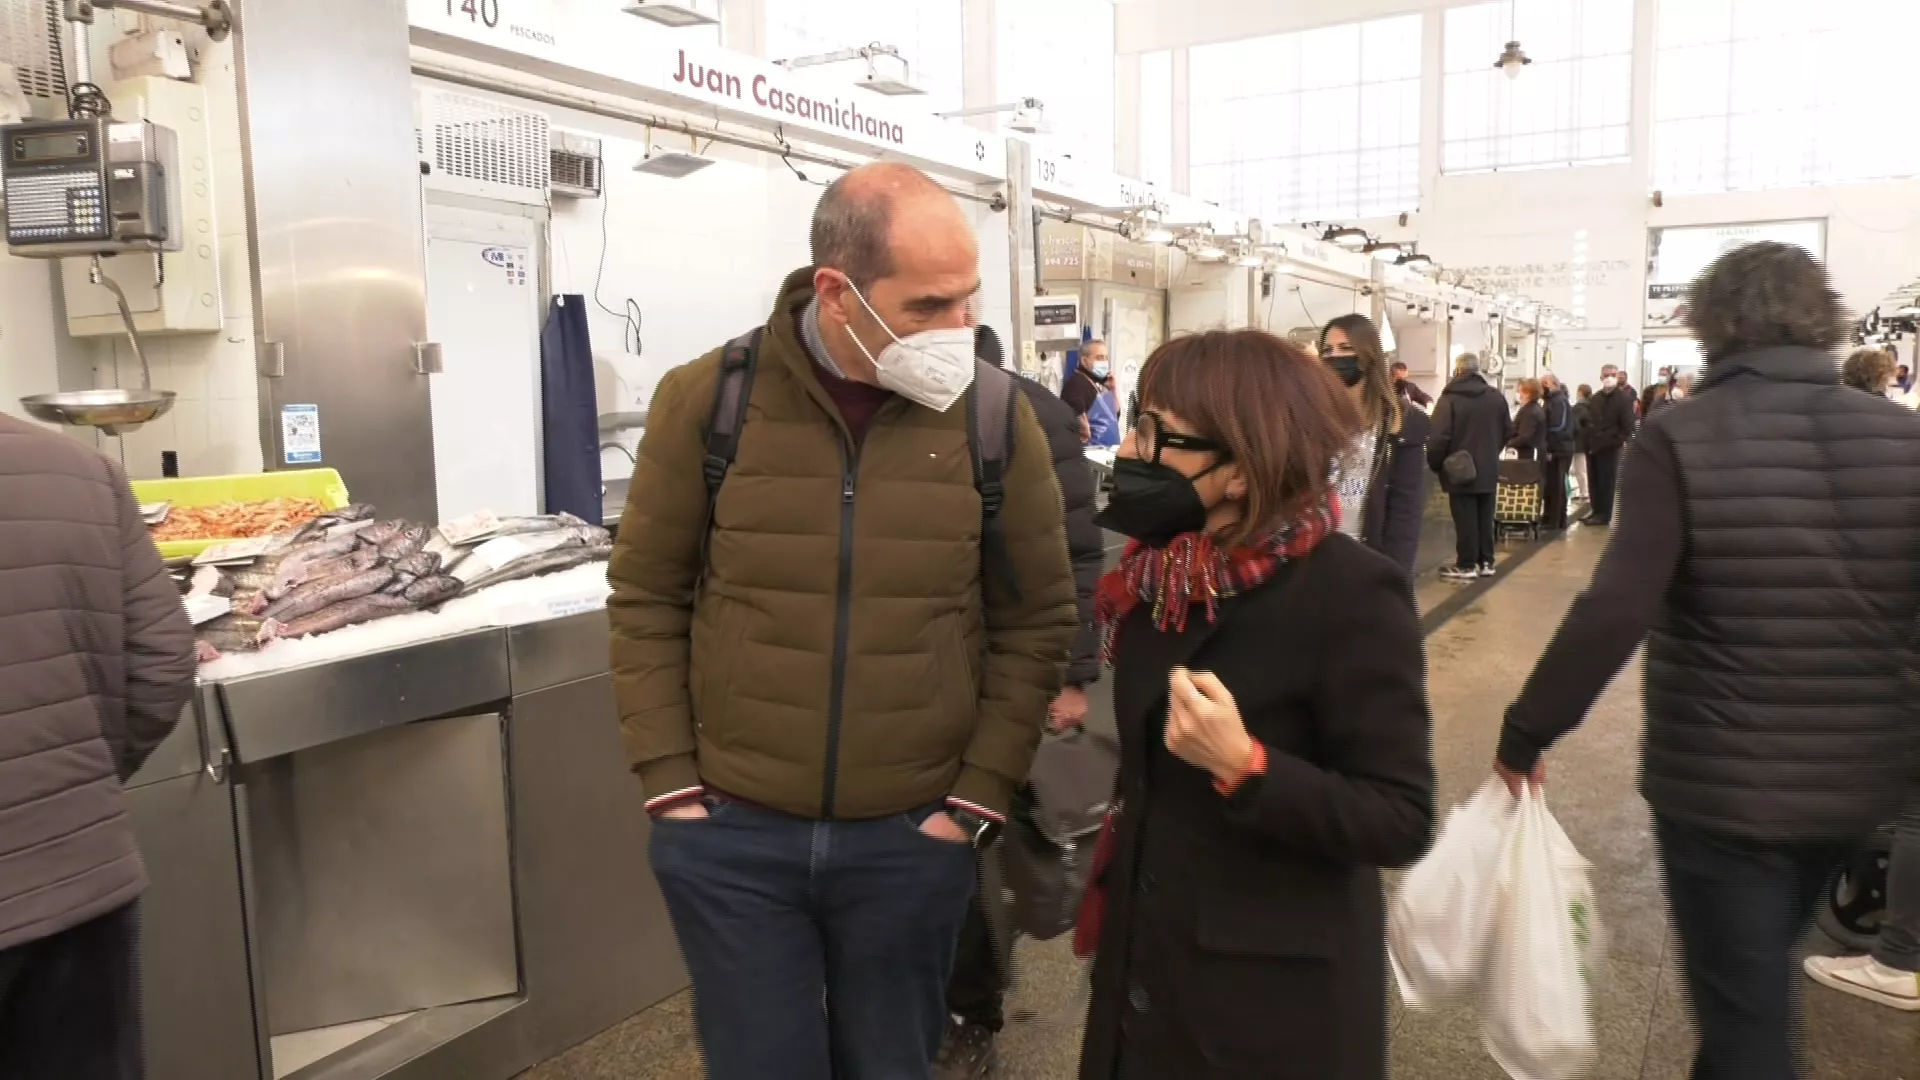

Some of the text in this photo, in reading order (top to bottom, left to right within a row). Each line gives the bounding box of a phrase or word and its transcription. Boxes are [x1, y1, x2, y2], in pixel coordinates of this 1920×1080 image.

[509, 24, 556, 46] PESCADOS
[672, 48, 904, 145] Juan Casamichana
[1037, 158, 1056, 182] 139
